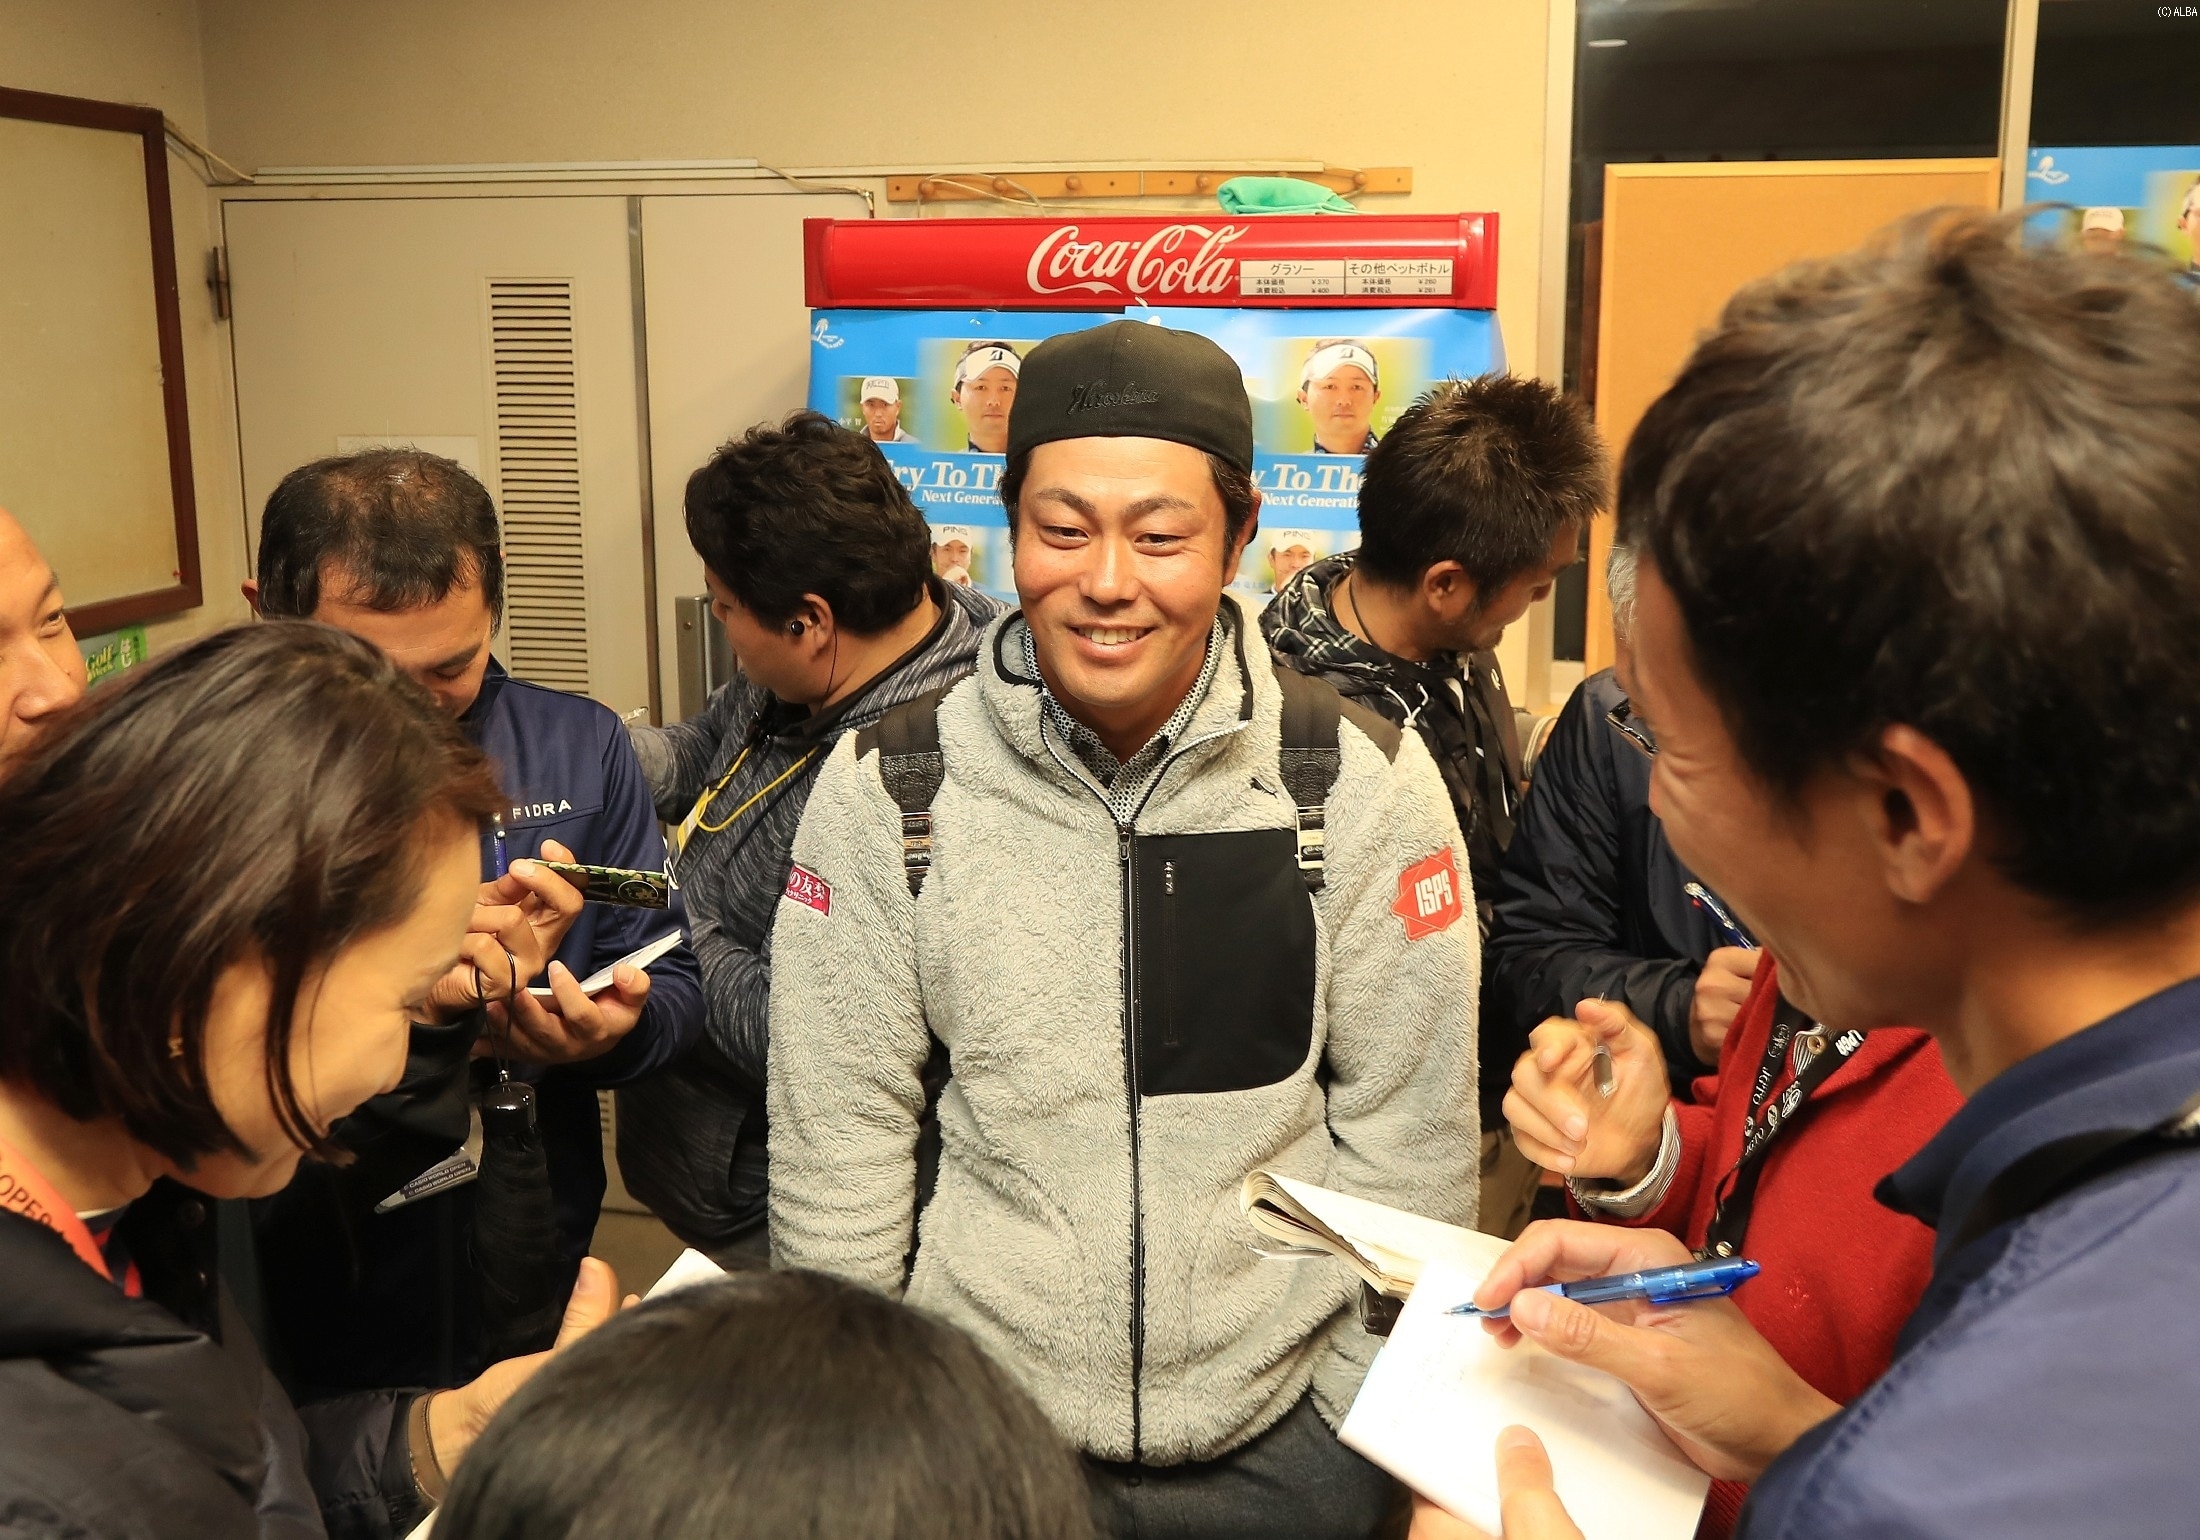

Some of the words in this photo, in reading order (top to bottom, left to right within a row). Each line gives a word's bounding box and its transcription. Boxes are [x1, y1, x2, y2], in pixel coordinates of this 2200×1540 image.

[1026, 224, 1250, 294] Coca-Cola
[1349, 262, 1450, 275] その他ペットボトル
[1270, 263, 1315, 276] グラソー
[932, 461, 968, 488] To
[1272, 463, 1313, 491] To
[921, 489, 952, 504] Next
[1262, 492, 1295, 506] Next
[512, 799, 572, 820] FIDRA
[1414, 868, 1454, 918] ISPS
[409, 1176, 428, 1188] CASIO
[428, 1168, 450, 1181] WORLD
